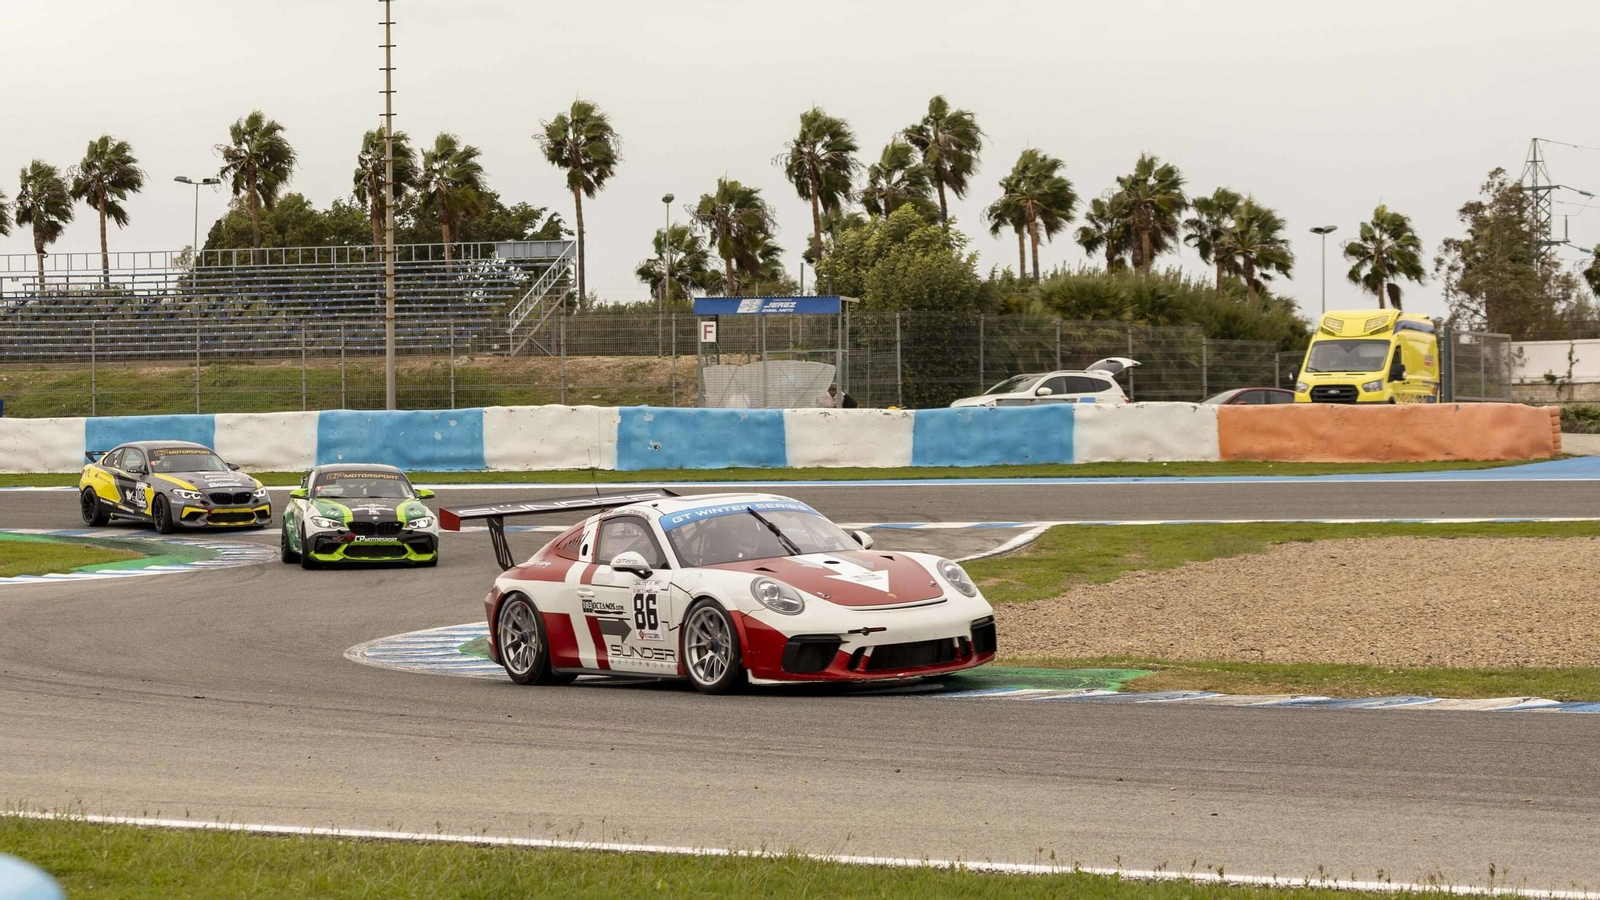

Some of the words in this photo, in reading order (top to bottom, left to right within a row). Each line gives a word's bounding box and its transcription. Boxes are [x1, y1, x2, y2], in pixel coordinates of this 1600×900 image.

[703, 324, 714, 340] F
[672, 513, 692, 524] GT
[694, 504, 751, 516] WINTER
[755, 502, 808, 511] SERIES
[633, 593, 659, 630] 86
[610, 643, 677, 661] SÜNDER
